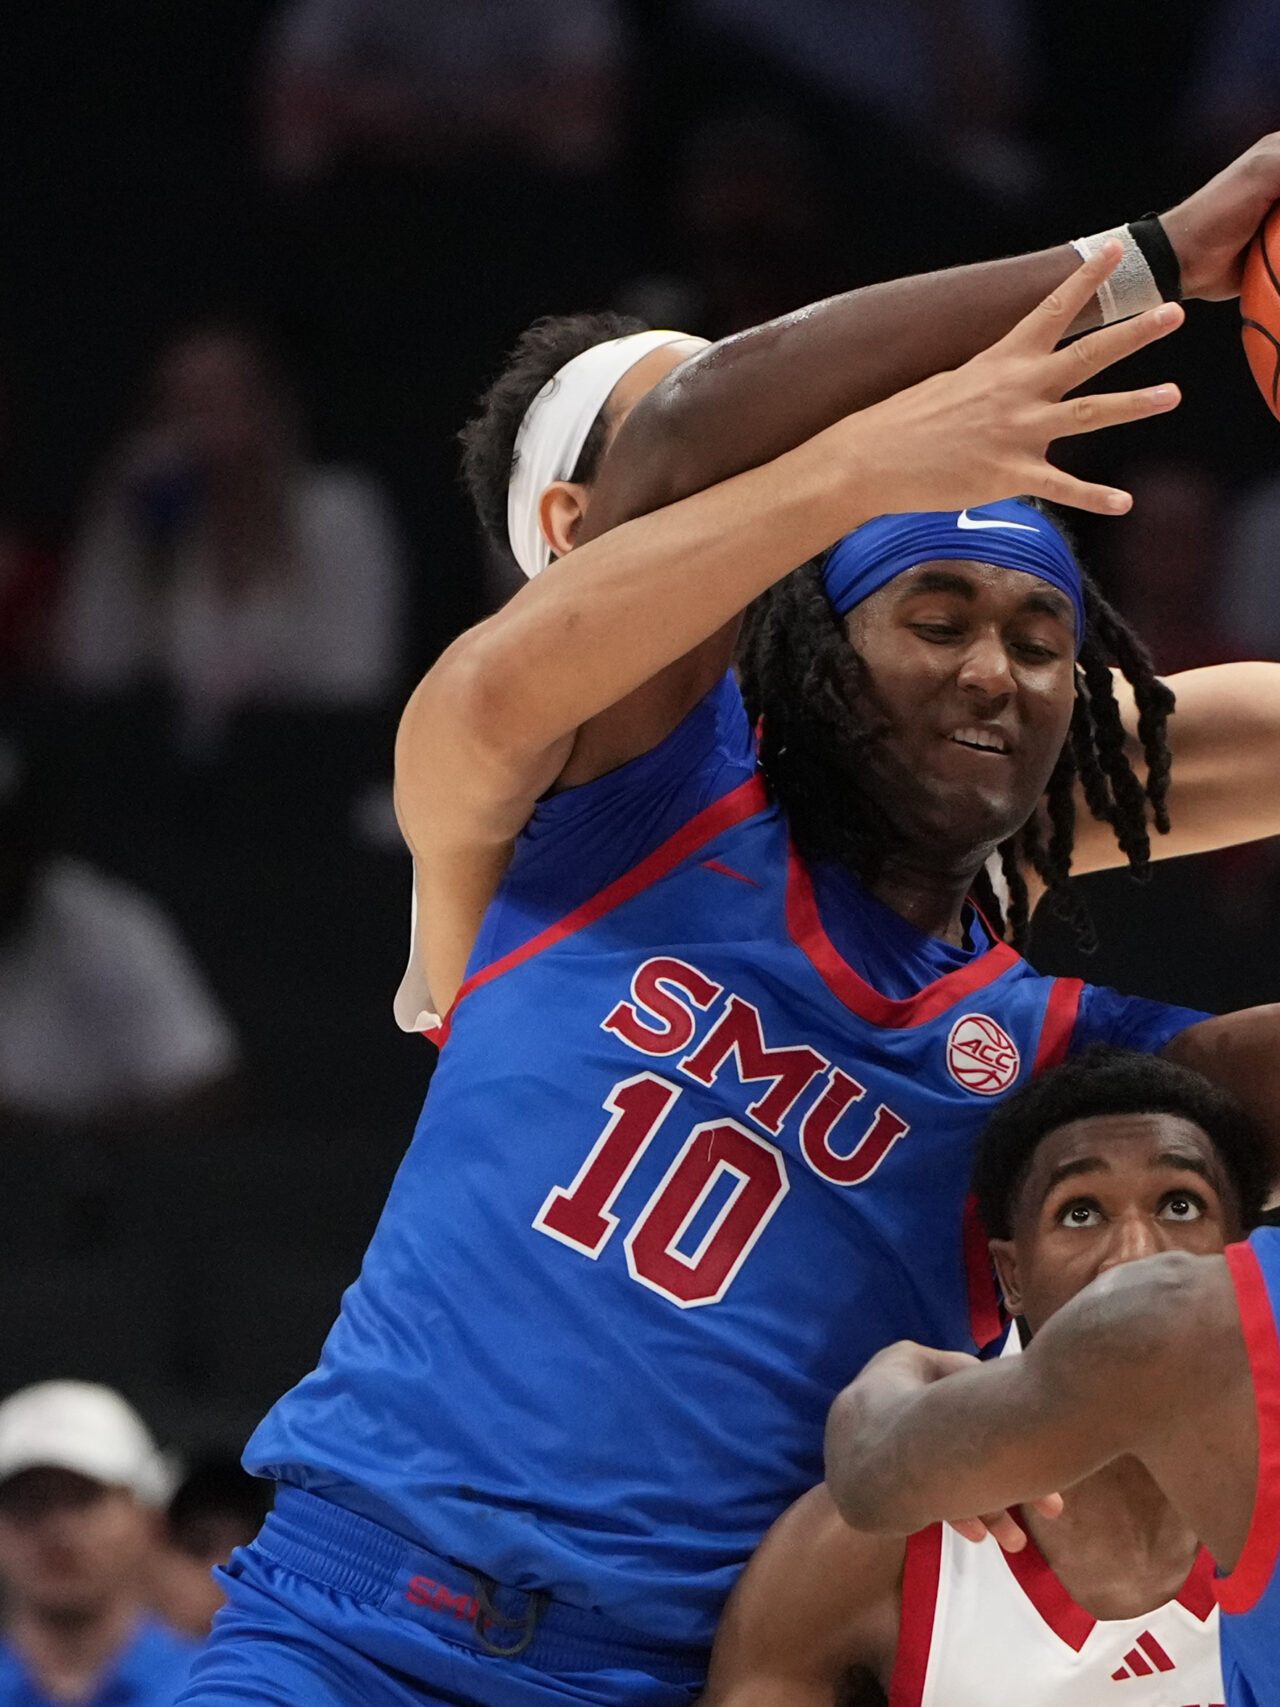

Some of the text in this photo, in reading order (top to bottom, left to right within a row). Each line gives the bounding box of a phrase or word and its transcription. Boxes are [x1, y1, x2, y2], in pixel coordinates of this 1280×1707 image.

[600, 956, 910, 1187] SMU
[957, 1038, 1017, 1070] ACC
[532, 1071, 791, 1310] 10
